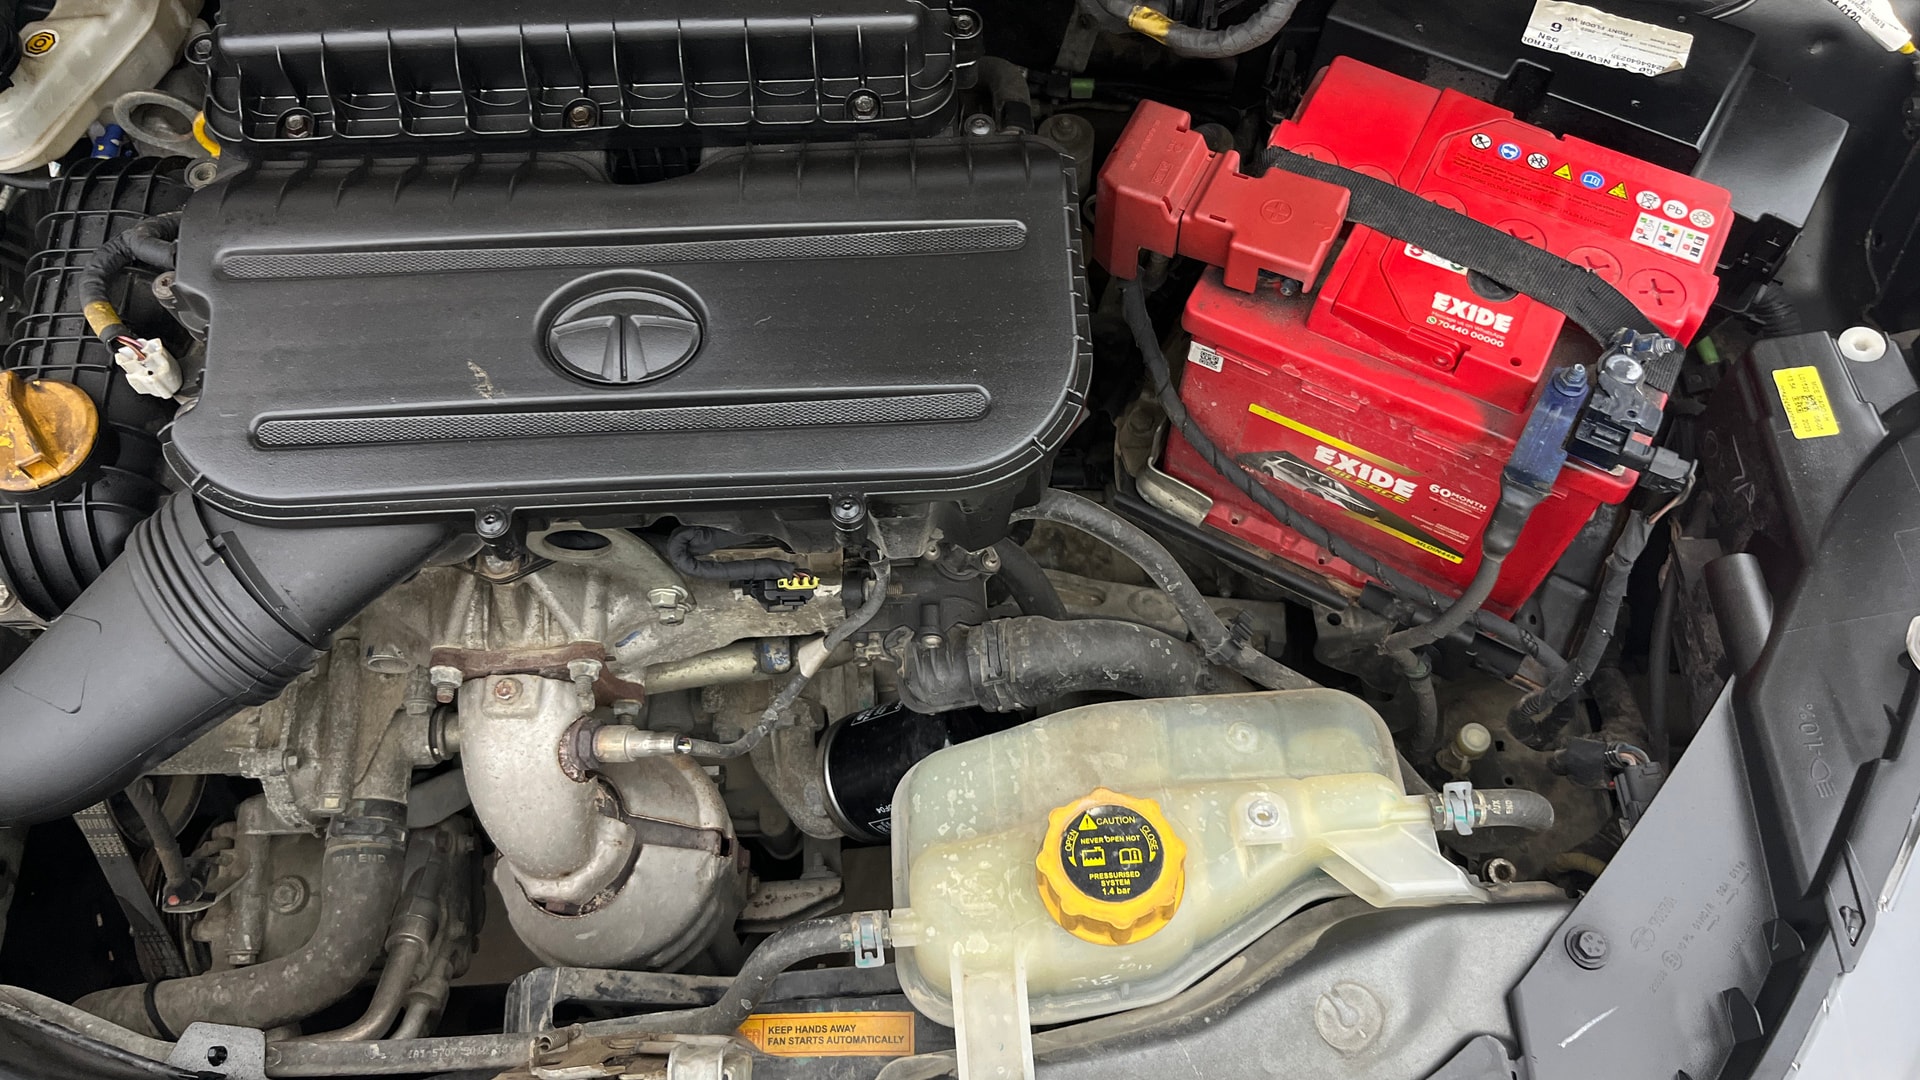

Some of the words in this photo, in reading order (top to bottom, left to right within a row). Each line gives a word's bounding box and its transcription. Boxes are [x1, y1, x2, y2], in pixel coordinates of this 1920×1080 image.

[1550, 22, 1563, 33] 6
[1580, 21, 1606, 31] FLOOR
[1607, 28, 1634, 38] FRONT
[1522, 36, 1560, 51] PETROL
[1587, 54, 1611, 65] NEW
[1666, 203, 1683, 216] Pb
[1432, 291, 1514, 334] EXIDE
[1437, 319, 1469, 335] 70440
[1470, 331, 1505, 348] 00000
[1314, 445, 1418, 499] EXIDE
[1325, 466, 1410, 504] MILEAGE
[1429, 483, 1451, 499] 60
[1451, 491, 1487, 510] MONTH
[1491, 799, 1501, 815] AUX
[1505, 799, 1514, 815] END
[1096, 816, 1136, 825] CAUTION
[1064, 829, 1078, 852] OPEN
[1080, 836, 1104, 845] NEVER
[1105, 835, 1125, 843] OPEN
[1125, 834, 1141, 842] HOT
[1141, 825, 1159, 851] CLOSE
[358, 853, 386, 863] END
[1089, 871, 1140, 880] PRESSURISED
[1101, 879, 1131, 887] SYSTEM
[1102, 887, 1115, 895] 1.4
[1116, 886, 1131, 895] bar
[768, 1026, 793, 1034] KEEP
[795, 1025, 828, 1034] HANDS
[829, 1024, 857, 1033] AWAY
[768, 1037, 786, 1046] FAN
[788, 1036, 824, 1045] STARTS
[826, 1035, 905, 1045] AUTOMATICALLY
